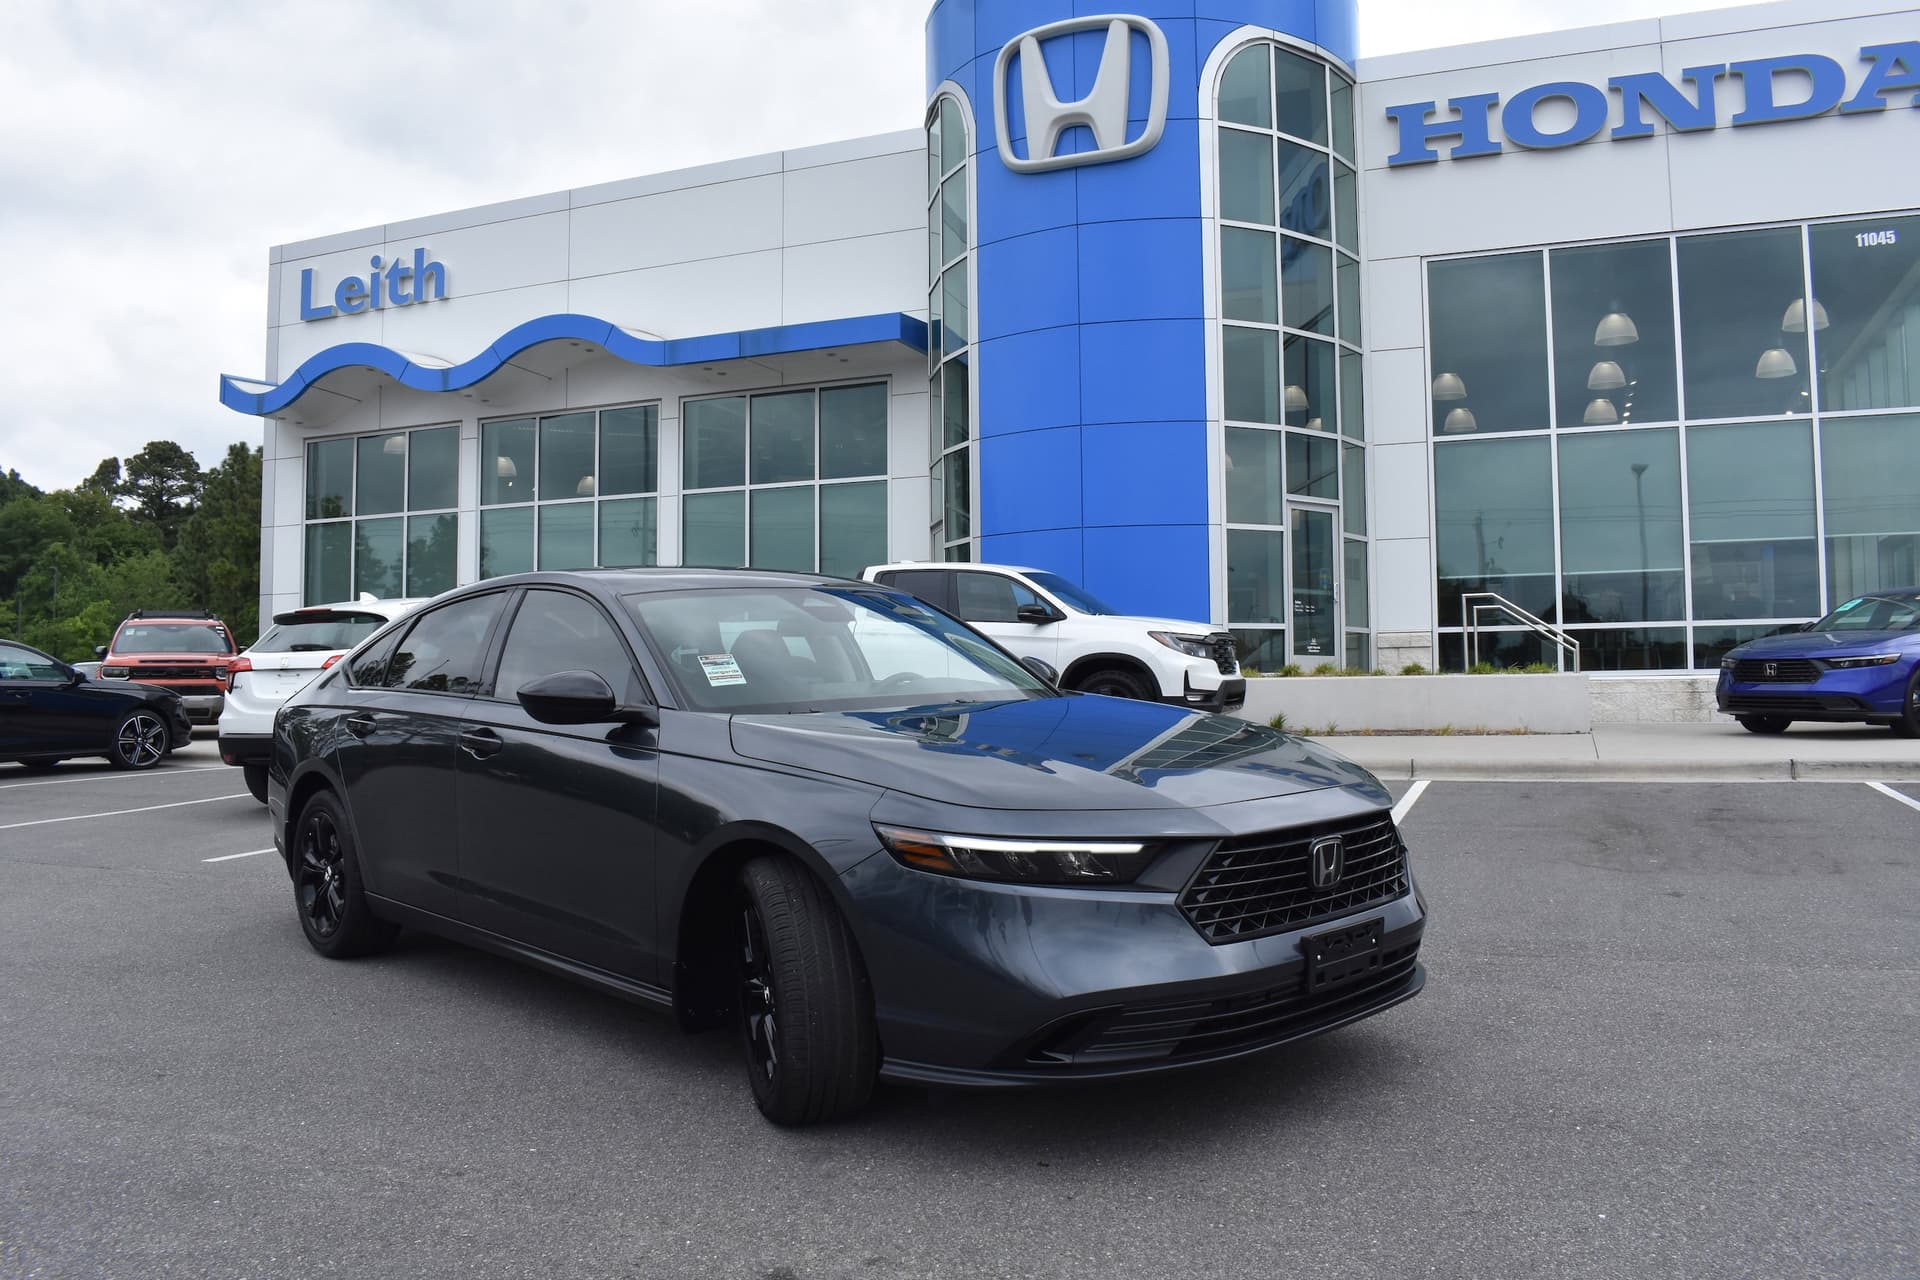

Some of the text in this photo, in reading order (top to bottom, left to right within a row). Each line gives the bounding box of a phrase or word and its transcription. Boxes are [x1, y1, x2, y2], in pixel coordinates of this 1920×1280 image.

[1385, 40, 1920, 167] HONDA
[1856, 230, 1896, 247] 11045
[300, 247, 447, 321] Leith
